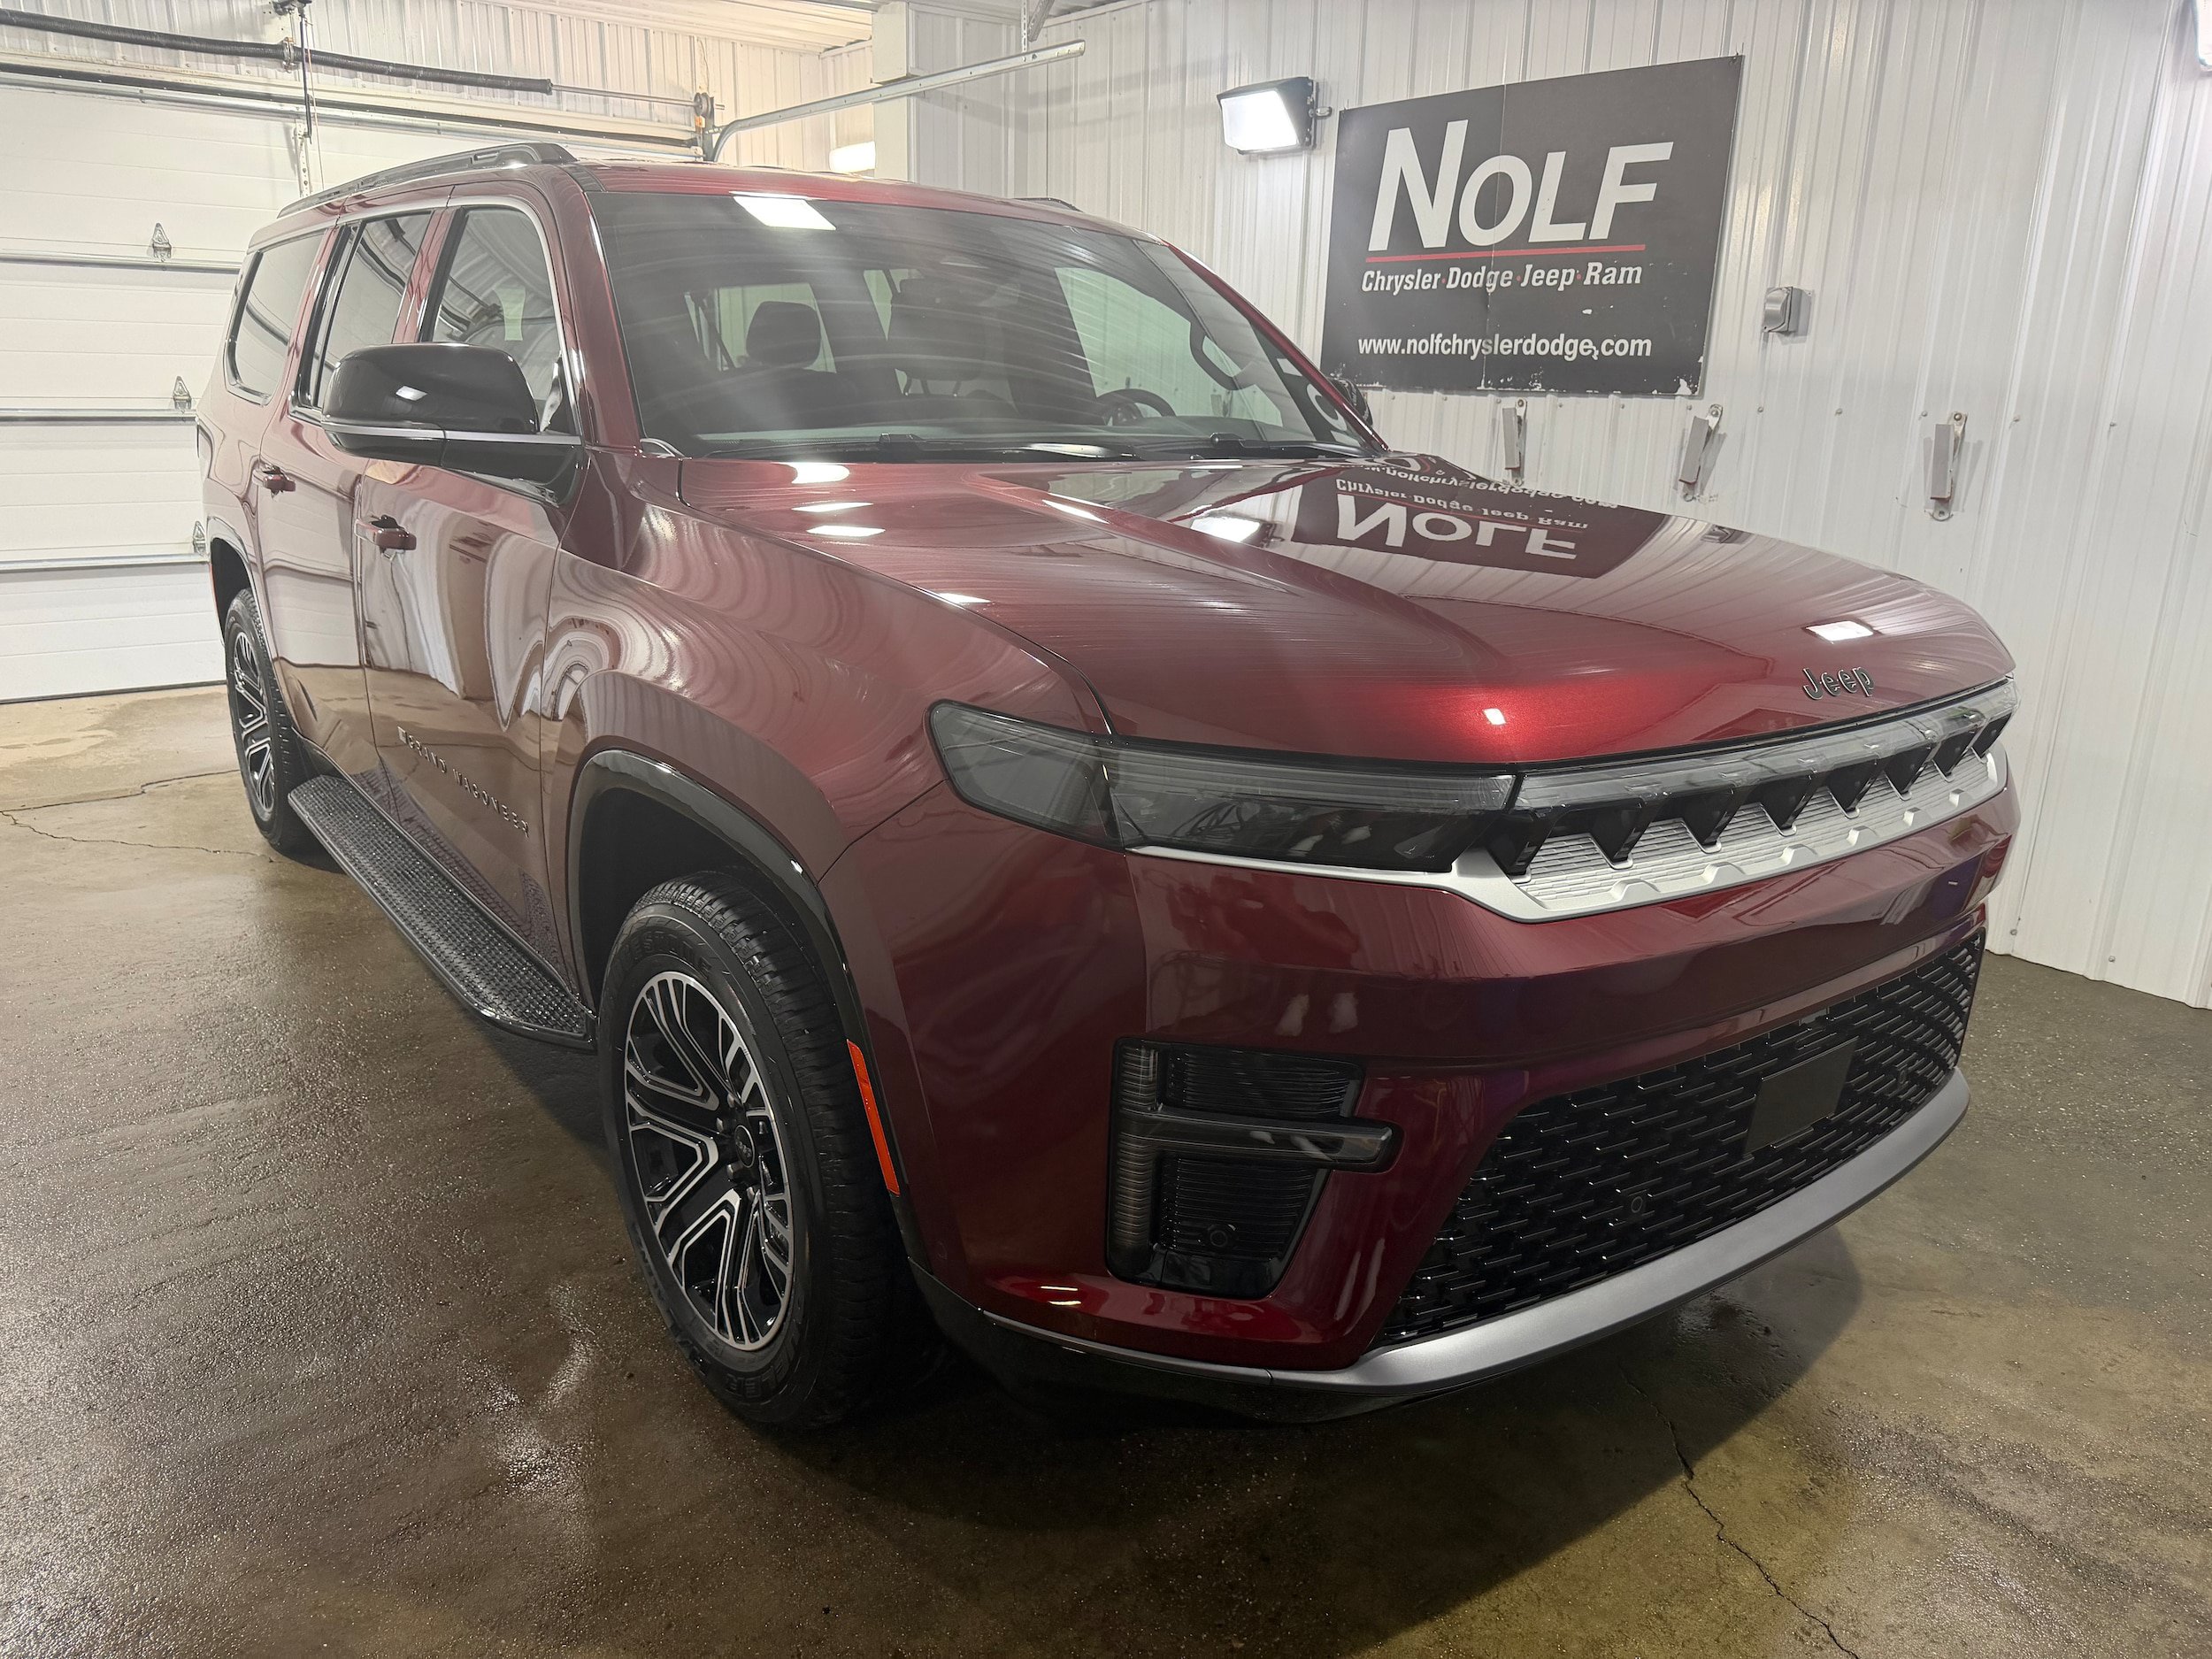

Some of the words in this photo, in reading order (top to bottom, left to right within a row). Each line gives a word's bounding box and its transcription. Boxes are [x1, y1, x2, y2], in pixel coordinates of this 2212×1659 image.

[1368, 119, 1674, 252] NOLF
[1361, 268, 1441, 296] Chrysler
[1446, 265, 1513, 295] Dodge
[1519, 264, 1577, 292] Jeep
[1583, 261, 1642, 287] Ram
[1357, 333, 1653, 362] www.nolfchryslerdodge.com
[1802, 667, 1875, 700] Jeep
